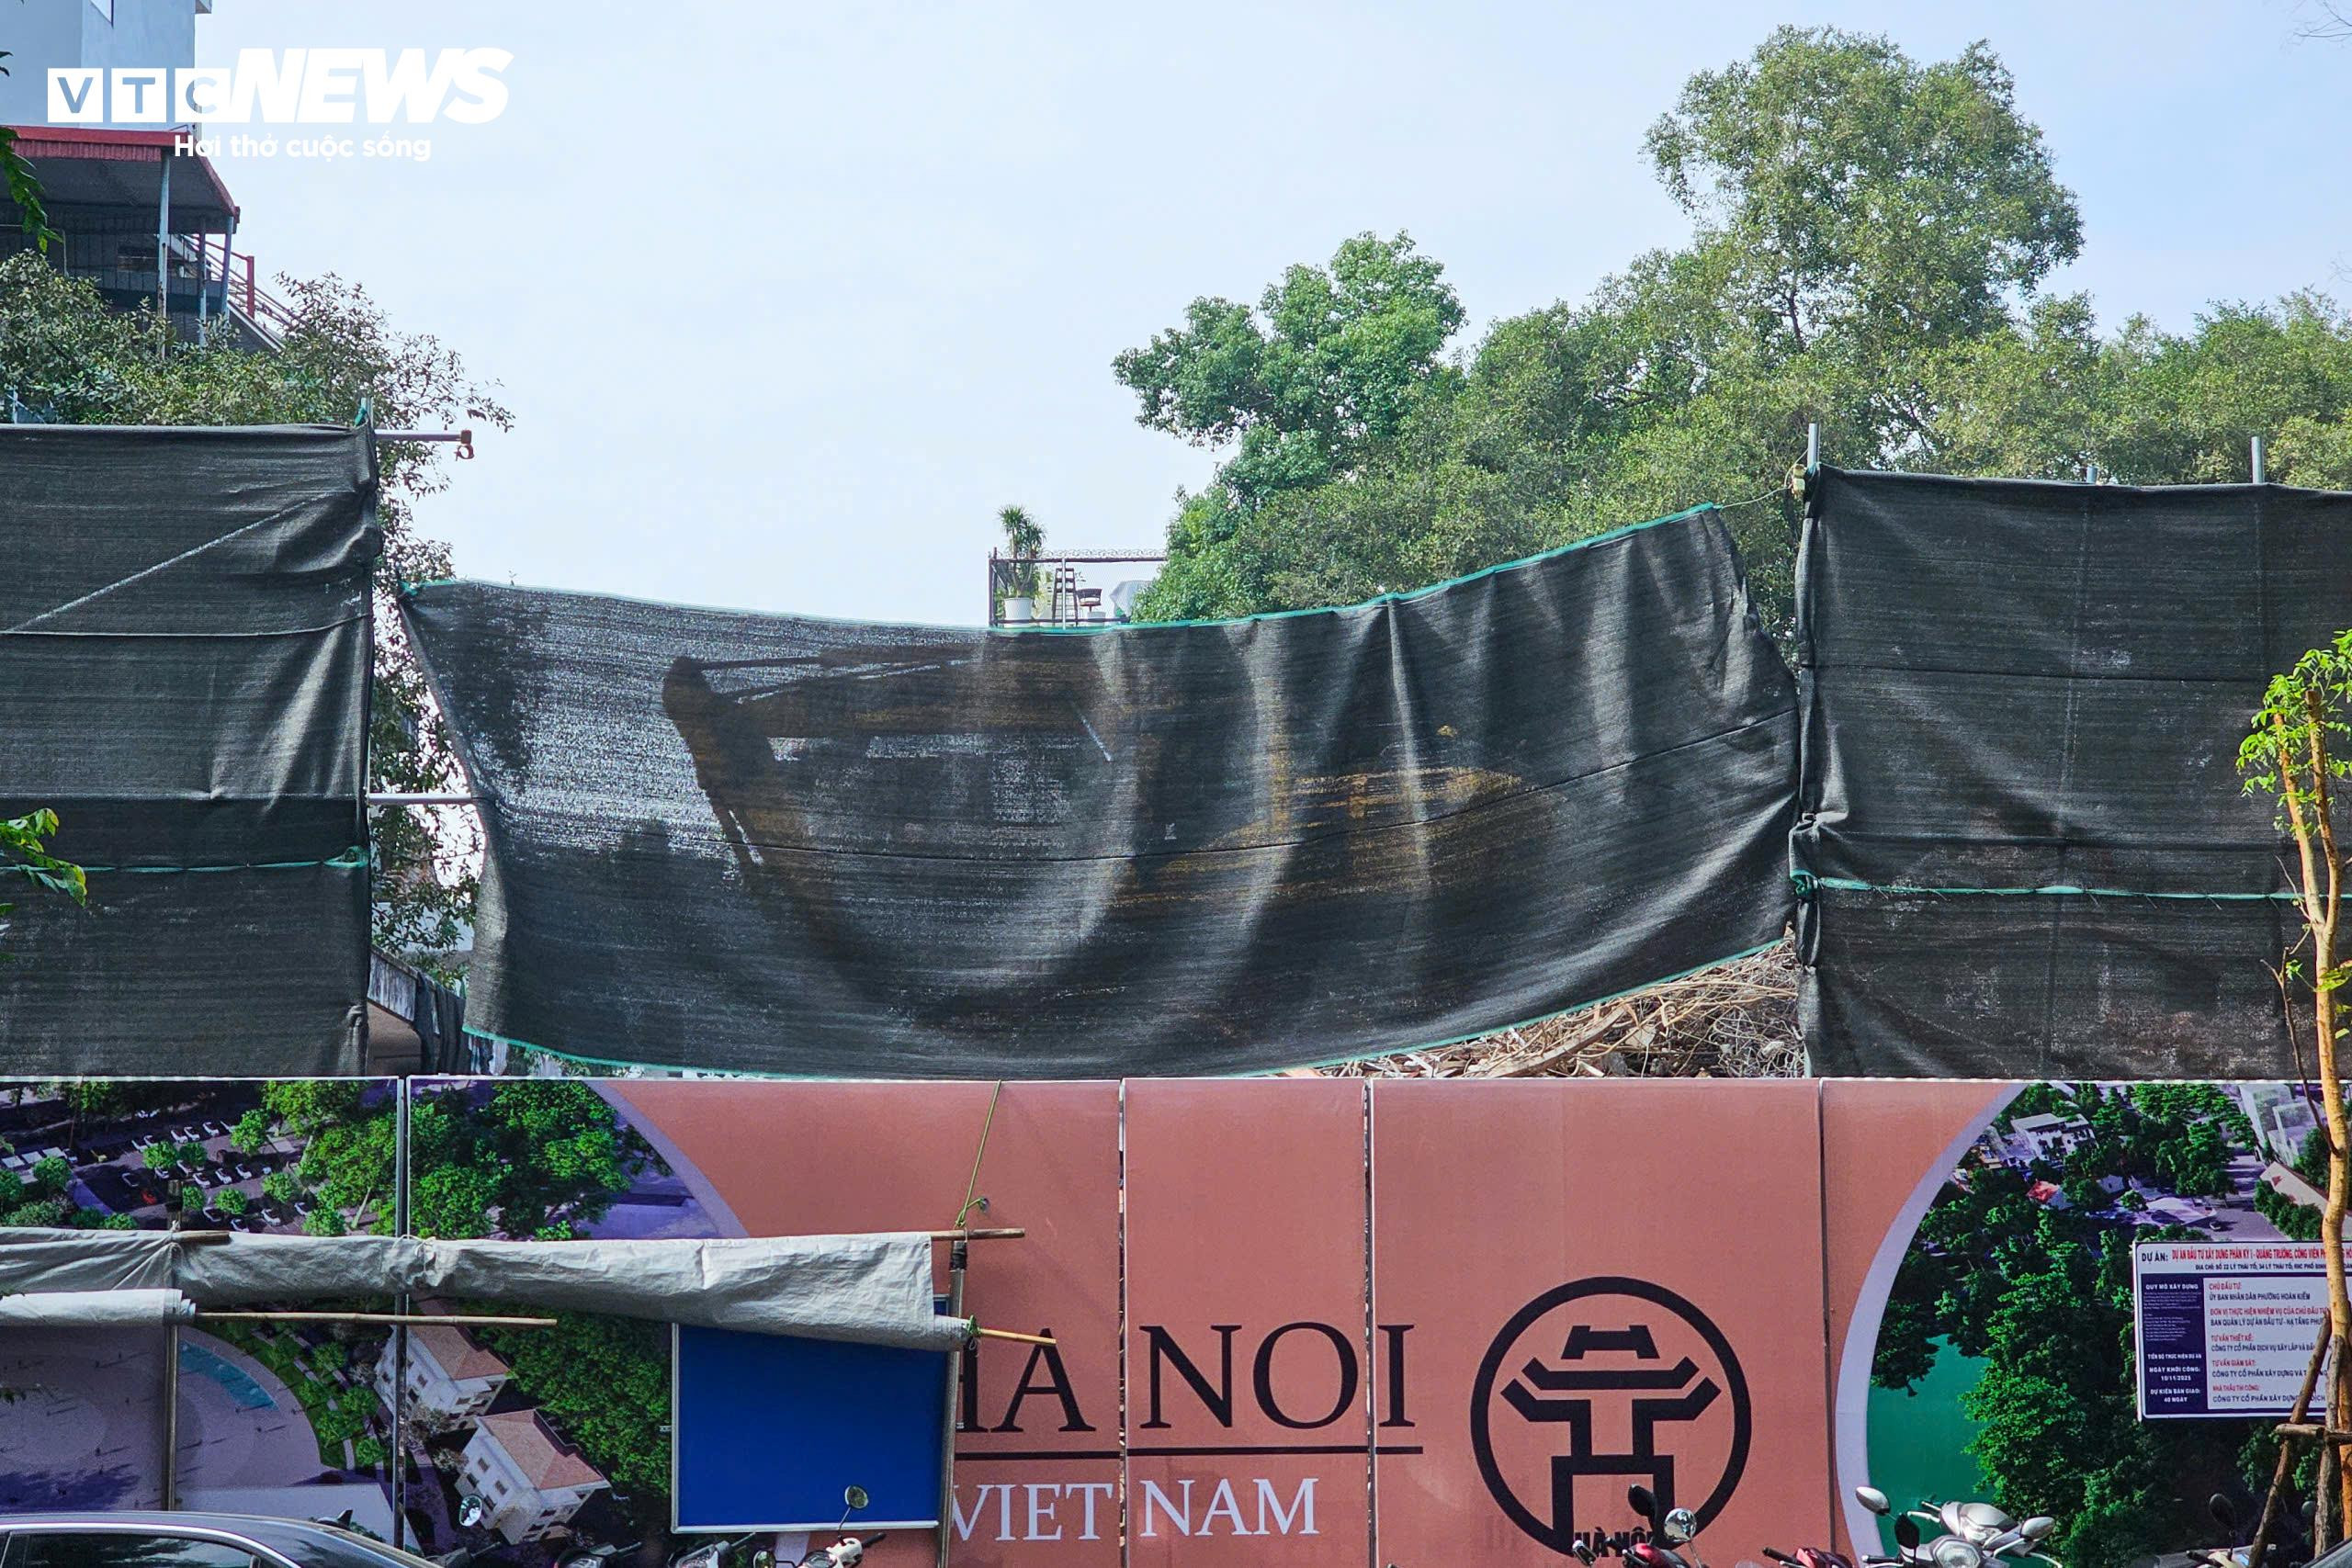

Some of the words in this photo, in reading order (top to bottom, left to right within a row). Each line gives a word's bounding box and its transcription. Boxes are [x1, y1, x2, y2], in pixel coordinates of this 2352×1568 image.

[1138, 1321, 1416, 1429] NOI
[953, 1482, 1114, 1541] VIET
[1138, 1477, 1321, 1538] NAM
